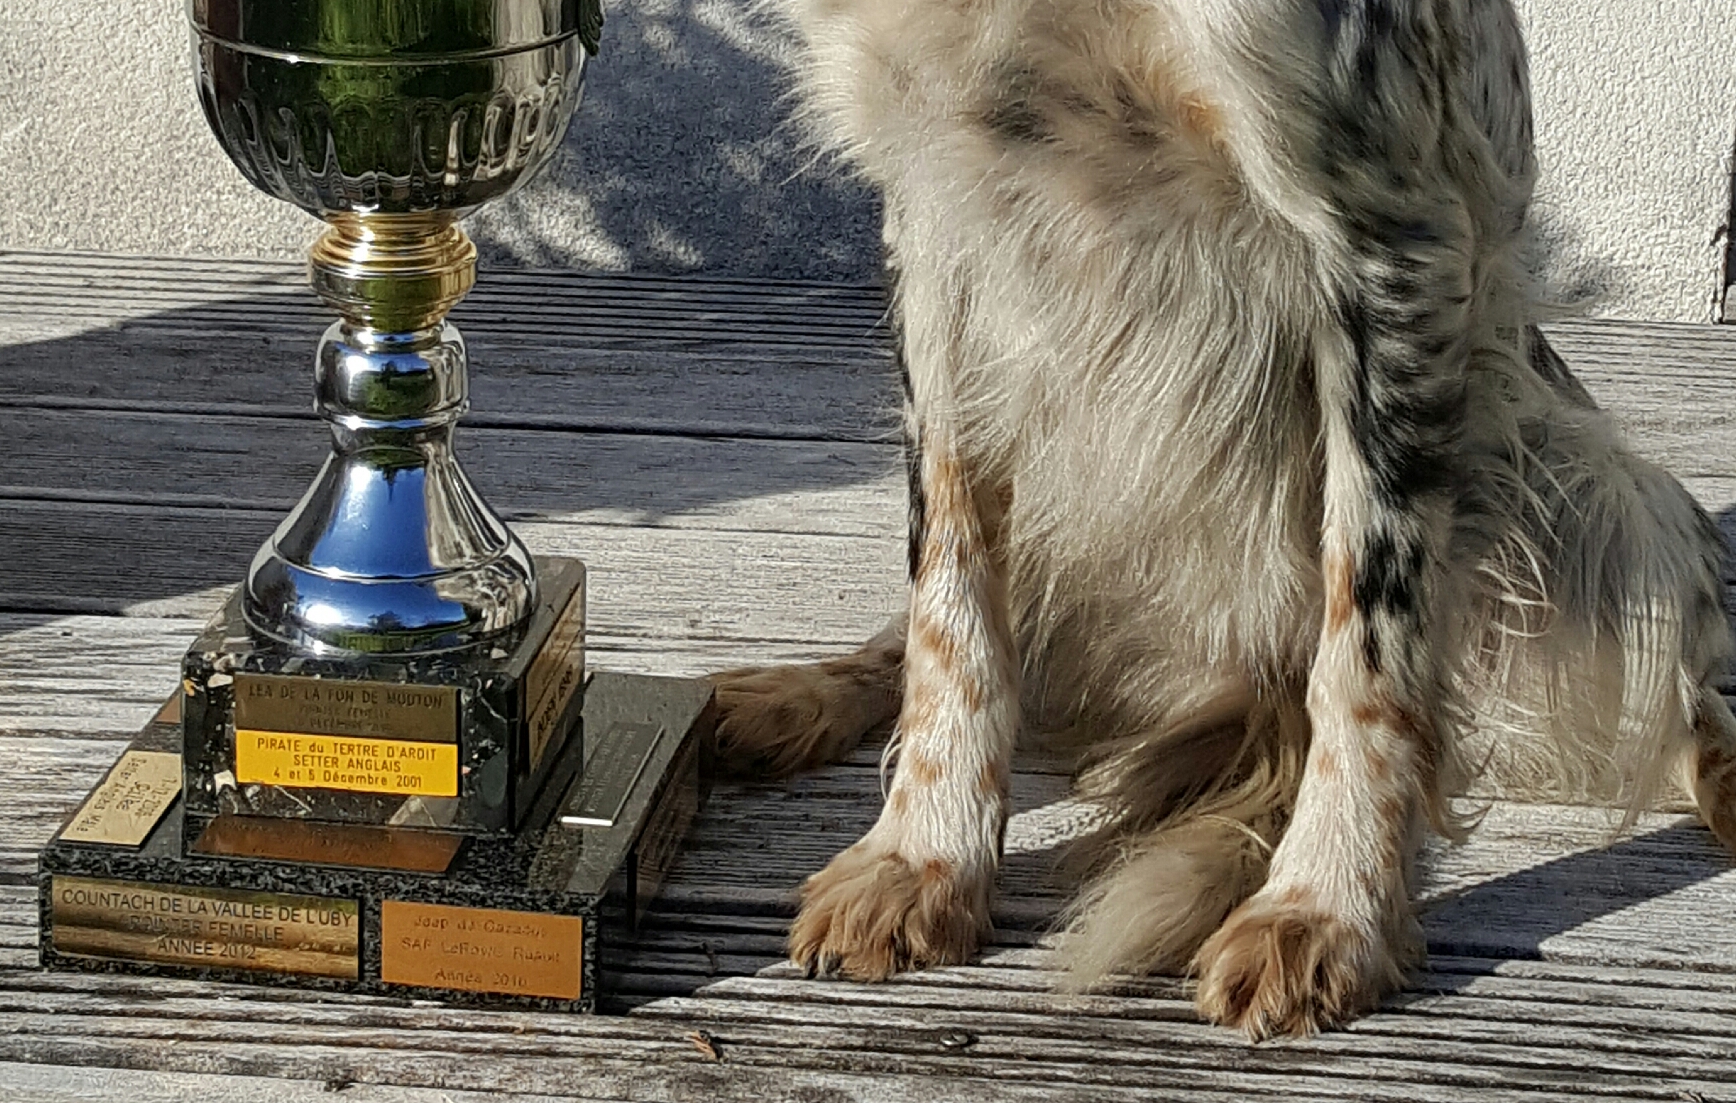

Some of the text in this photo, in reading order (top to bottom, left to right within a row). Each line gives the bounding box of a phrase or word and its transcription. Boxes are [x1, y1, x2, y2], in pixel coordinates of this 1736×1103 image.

[280, 684, 297, 699] DE
[362, 688, 379, 704] DE
[257, 737, 437, 761] PIRATE du TERTRE D'ARDIT
[294, 754, 401, 773] SETTER ANGLAIS
[273, 767, 422, 788] 4 et 5 Décembre 2001
[61, 888, 155, 912] COUNTACH
[159, 897, 182, 913] DE
[188, 898, 207, 914] LA
[212, 901, 273, 921] VALLEE
[278, 906, 300, 923] DE
[129, 915, 285, 942] POINTER FEMELLE
[219, 941, 256, 960] 2012
